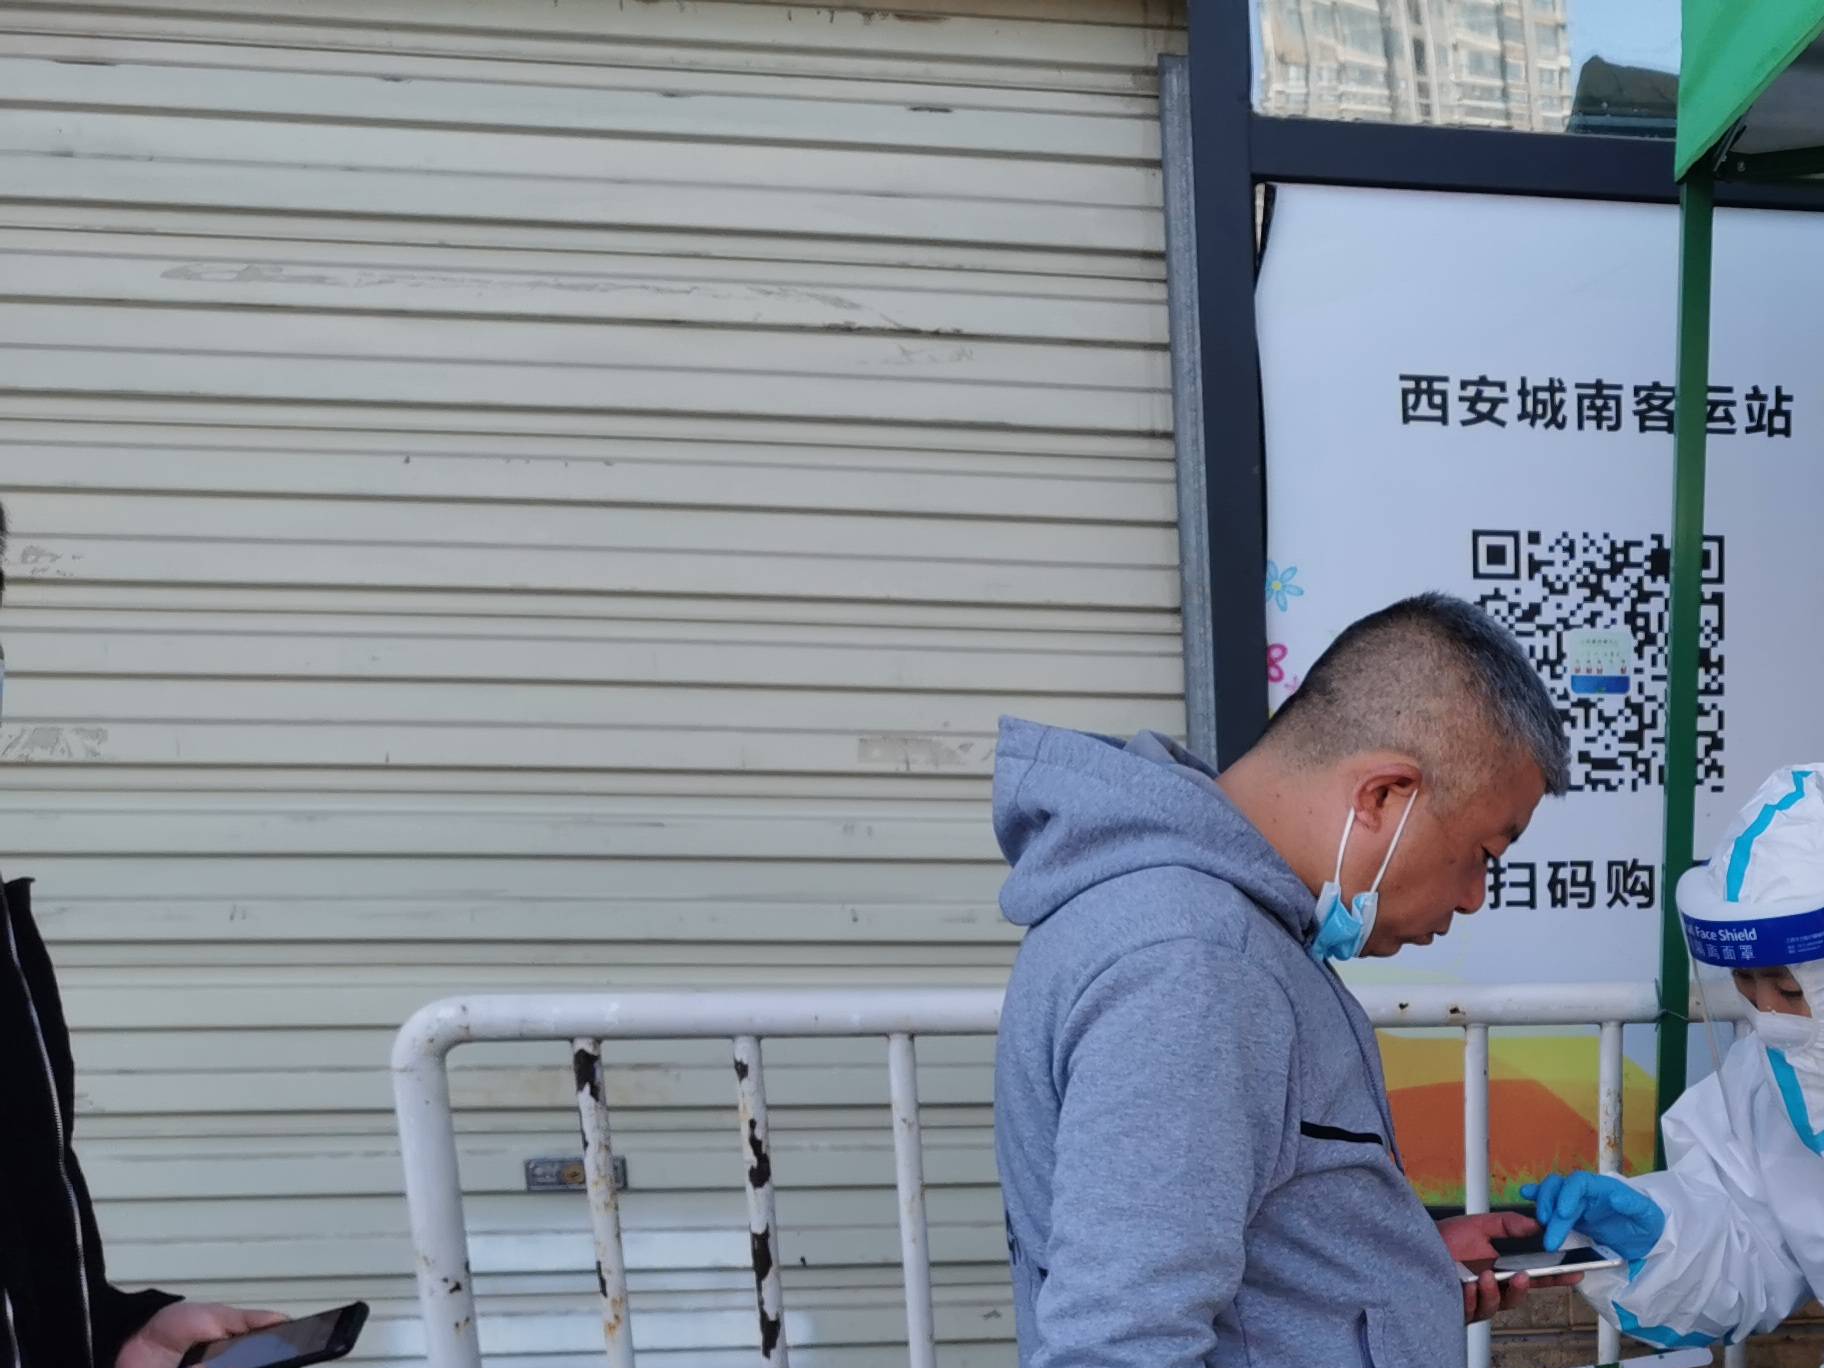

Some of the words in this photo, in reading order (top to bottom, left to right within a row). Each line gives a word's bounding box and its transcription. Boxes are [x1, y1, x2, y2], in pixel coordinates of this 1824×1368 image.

[1398, 373, 1794, 439] 西安城南客运站
[1487, 857, 1664, 911] 扫码购
[1695, 925, 1717, 941] Face
[1718, 927, 1758, 942] Shield
